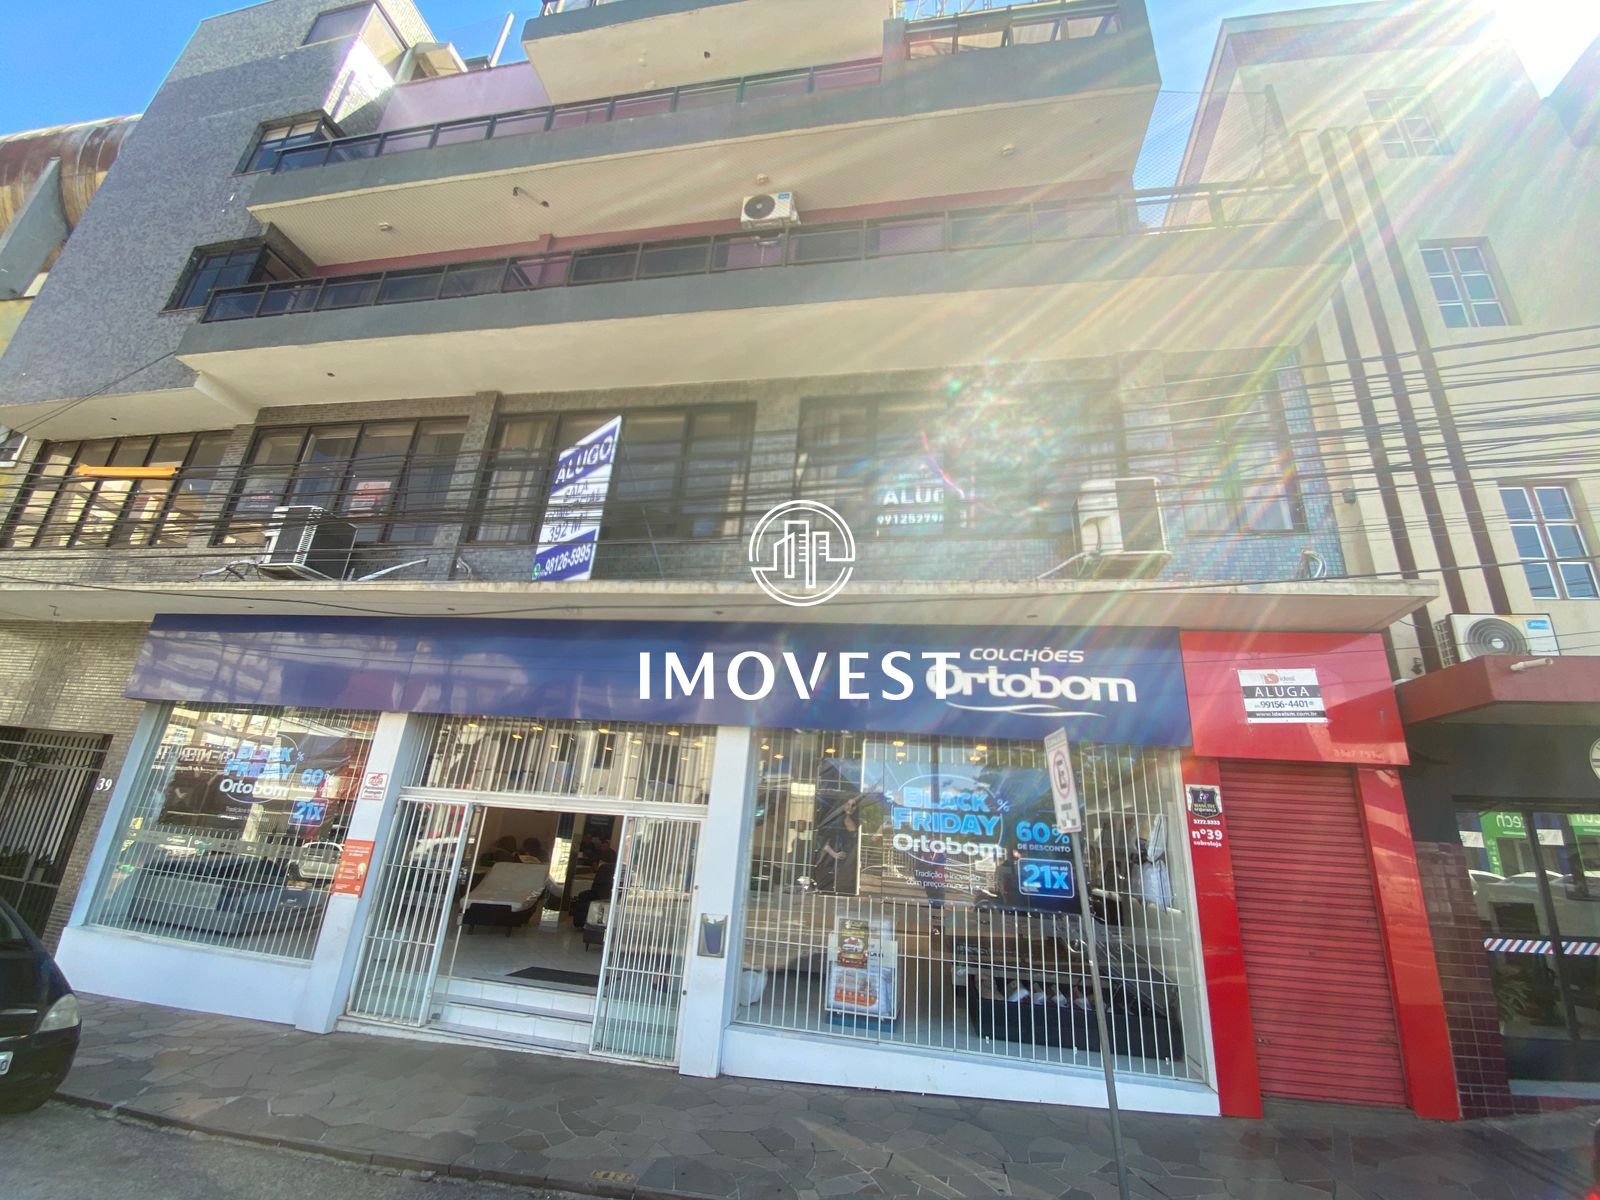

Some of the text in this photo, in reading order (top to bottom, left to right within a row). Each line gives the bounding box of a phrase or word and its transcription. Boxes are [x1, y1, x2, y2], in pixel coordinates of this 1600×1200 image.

[555, 435, 612, 484] ALUGO
[545, 544, 591, 575] 98126-5995
[969, 647, 1085, 663] COLCHÕES
[926, 665, 1137, 702] Ortobom
[1254, 686, 1311, 697] ALUGA
[1260, 700, 1309, 709] 99156-4401
[96, 777, 113, 791] 39
[219, 778, 289, 797] Ortobom
[903, 786, 991, 812] BLACK
[893, 806, 1001, 836] FRIDAY
[1015, 820, 1070, 845] 60%
[892, 833, 1004, 859] Ortobom
[1029, 844, 1071, 853] DESCONTO
[1023, 864, 1070, 890] 21x
